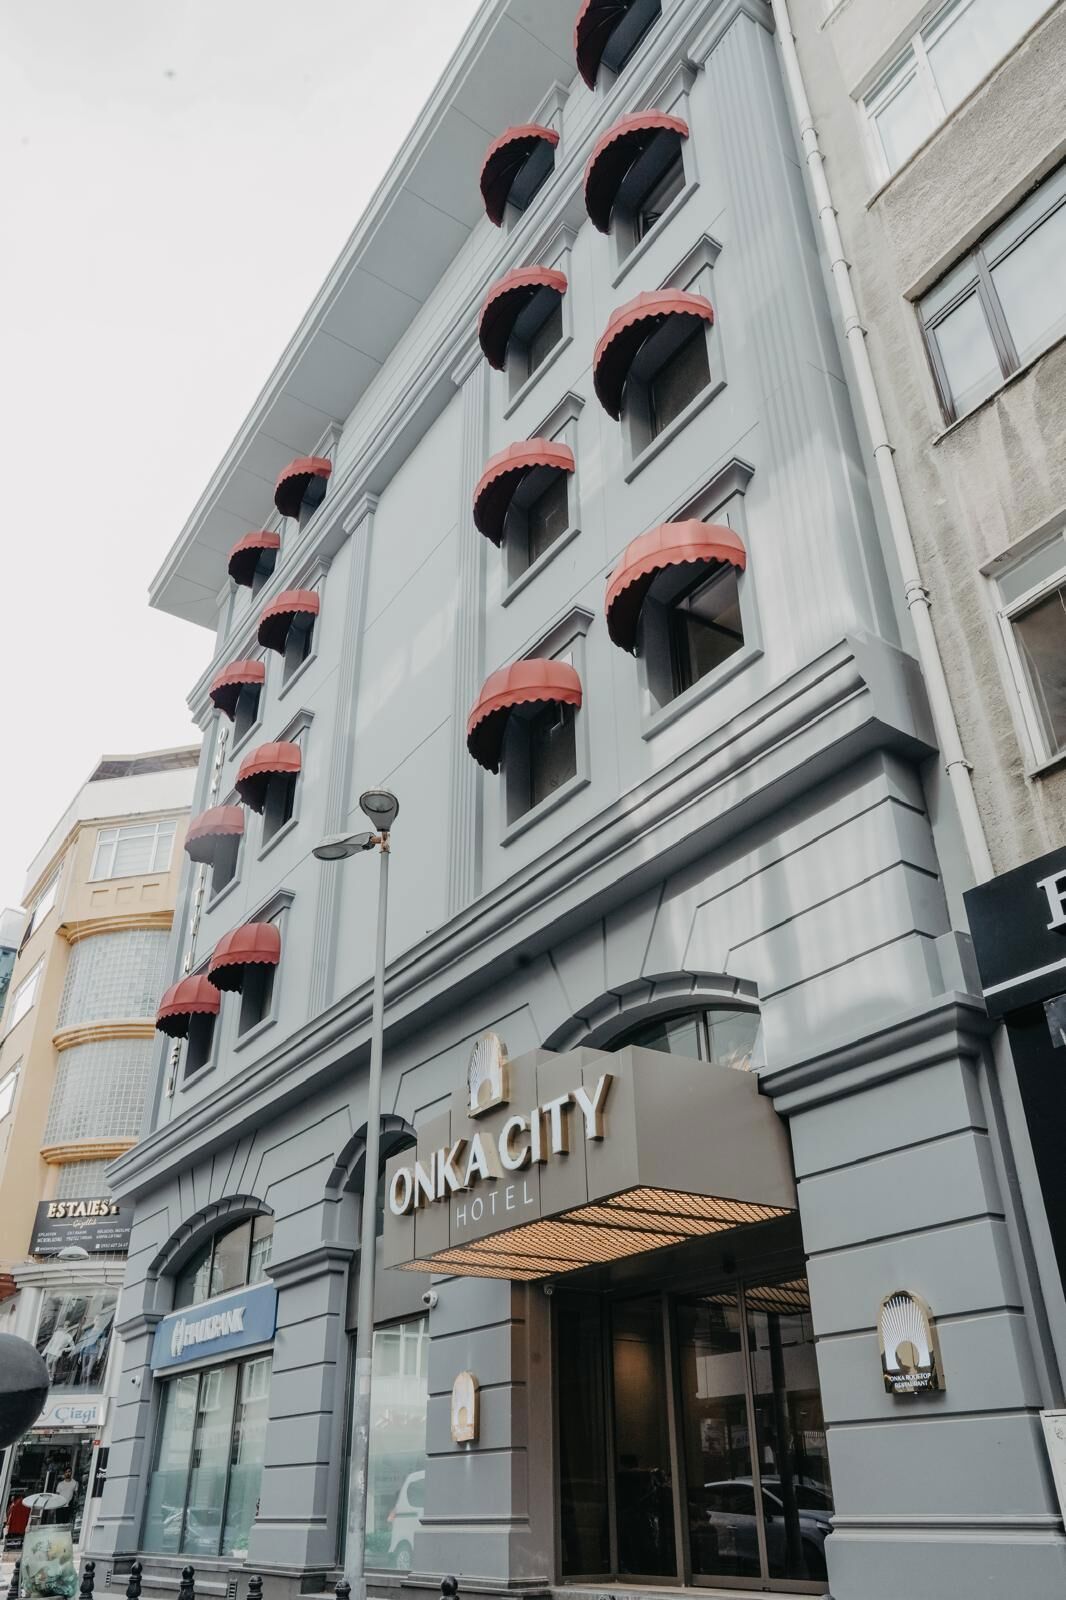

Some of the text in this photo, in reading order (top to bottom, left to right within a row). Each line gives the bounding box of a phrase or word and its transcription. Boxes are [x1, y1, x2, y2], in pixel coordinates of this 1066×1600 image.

[389, 1073, 614, 1216] ONKA CITY
[456, 1180, 534, 1229] HOTEL
[895, 1380, 928, 1388] RESTAURANT
